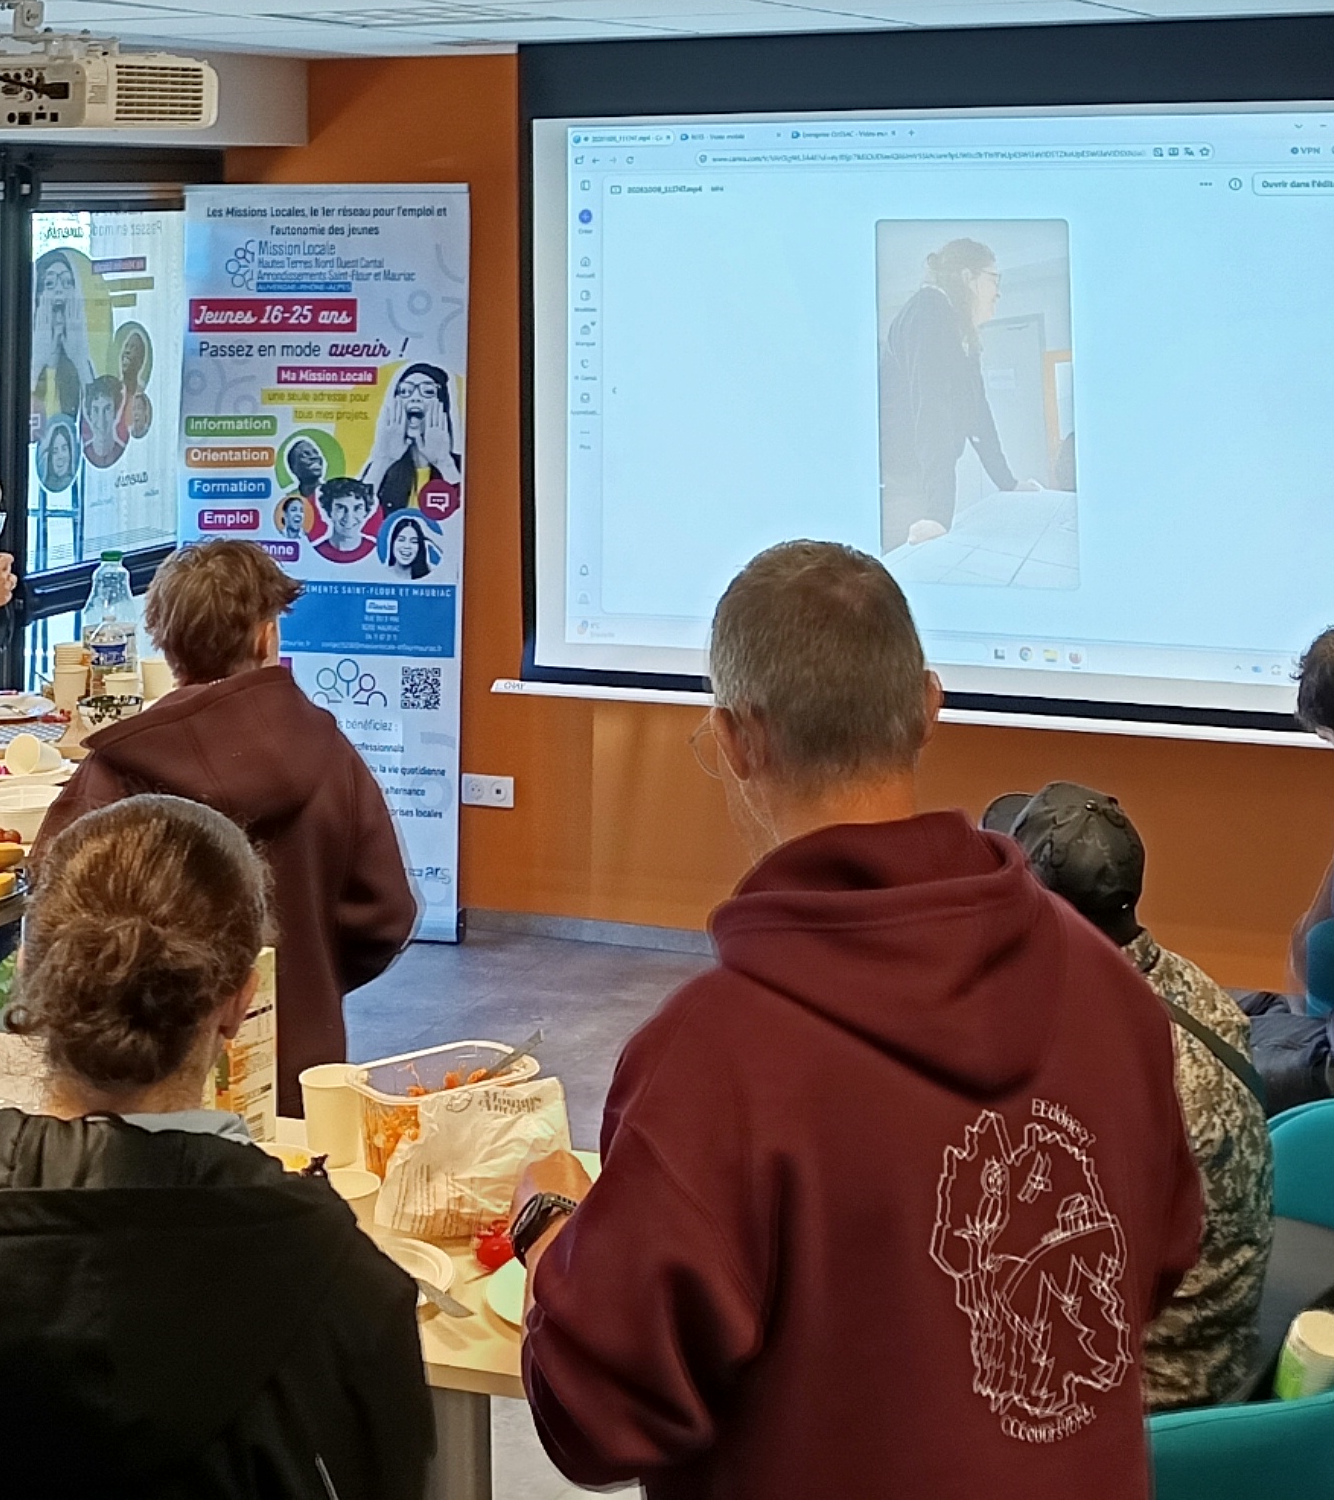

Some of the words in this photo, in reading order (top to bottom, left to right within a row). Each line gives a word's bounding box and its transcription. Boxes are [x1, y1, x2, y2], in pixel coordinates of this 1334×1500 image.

[1261, 180, 1288, 188] Ouvrir
[207, 207, 223, 217] Les
[225, 206, 267, 217] Missions
[270, 206, 308, 218] Locales,
[310, 206, 319, 217] le
[337, 206, 370, 217] réseau
[372, 208, 395, 219] pour
[397, 206, 434, 219] l'emploi
[436, 207, 447, 217] et
[270, 224, 325, 235] l'autonomie
[328, 224, 345, 235] des
[347, 224, 380, 237] jeunes
[258, 240, 301, 256] Mission
[303, 241, 336, 256] Locale
[194, 305, 258, 325] Jeunes
[260, 305, 312, 324] 16-25
[318, 311, 353, 324] ans
[199, 341, 253, 357] Passez
[258, 345, 277, 357] en
[281, 341, 321, 357] mode
[328, 338, 391, 357] avenir
[398, 337, 409, 357] !
[281, 370, 297, 381] Ma
[299, 370, 338, 382] Mission
[340, 370, 373, 382] Locale
[267, 392, 286, 401] une
[287, 391, 310, 401] seule
[311, 391, 347, 401] adresse
[349, 392, 370, 403] pour
[190, 418, 271, 430] Information
[191, 449, 269, 462] Orientation
[193, 480, 266, 492] Formation
[203, 511, 254, 527] Emploi
[341, 586, 396, 596] SAINT-FLOUR
[399, 588, 409, 596] ET
[413, 588, 452, 597] MAURIAC
[346, 719, 392, 731] bénéficiez
[379, 765, 387, 773] la
[388, 766, 399, 774] vie
[401, 766, 446, 777] quotidienne
[416, 809, 442, 818] locales
